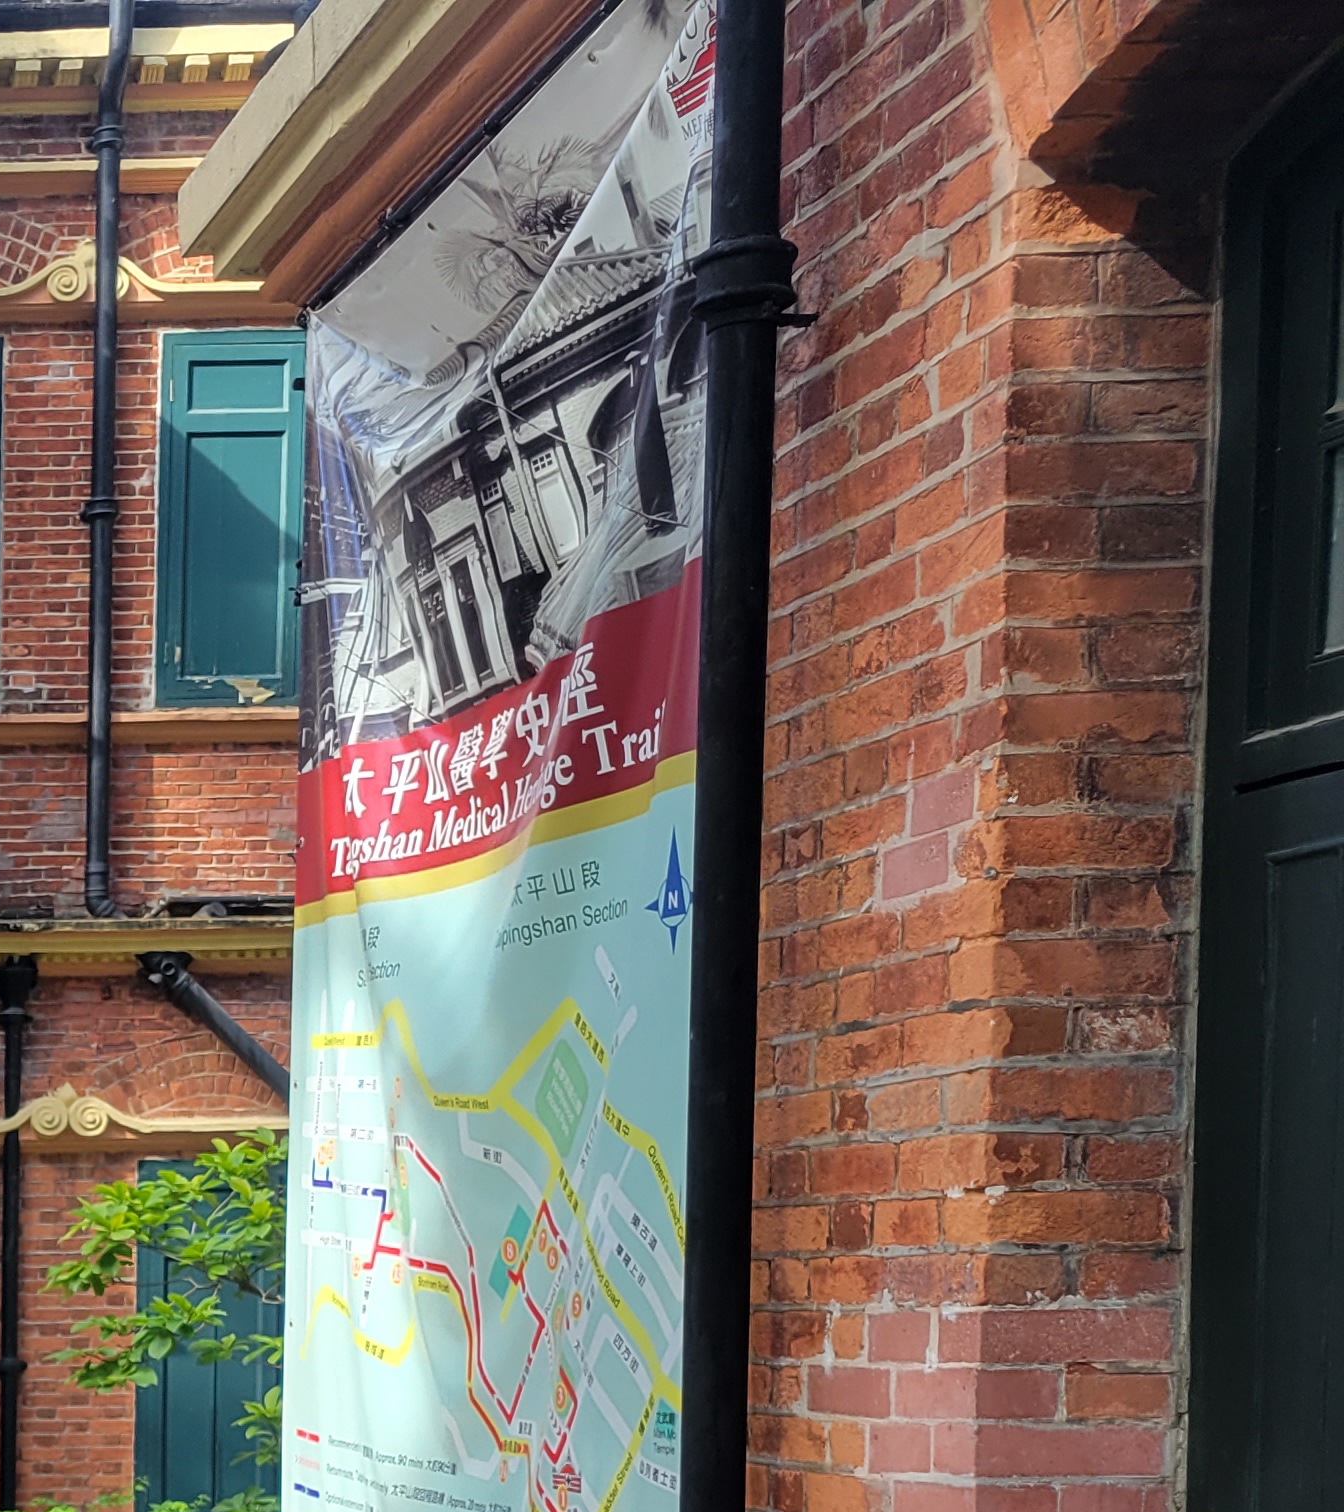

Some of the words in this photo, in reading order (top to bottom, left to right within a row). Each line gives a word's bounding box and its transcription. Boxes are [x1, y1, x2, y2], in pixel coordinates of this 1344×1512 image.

[425, 781, 510, 853] Medical
[581, 897, 629, 928] Section
[667, 889, 679, 911] N
[471, 1098, 490, 1110] West
